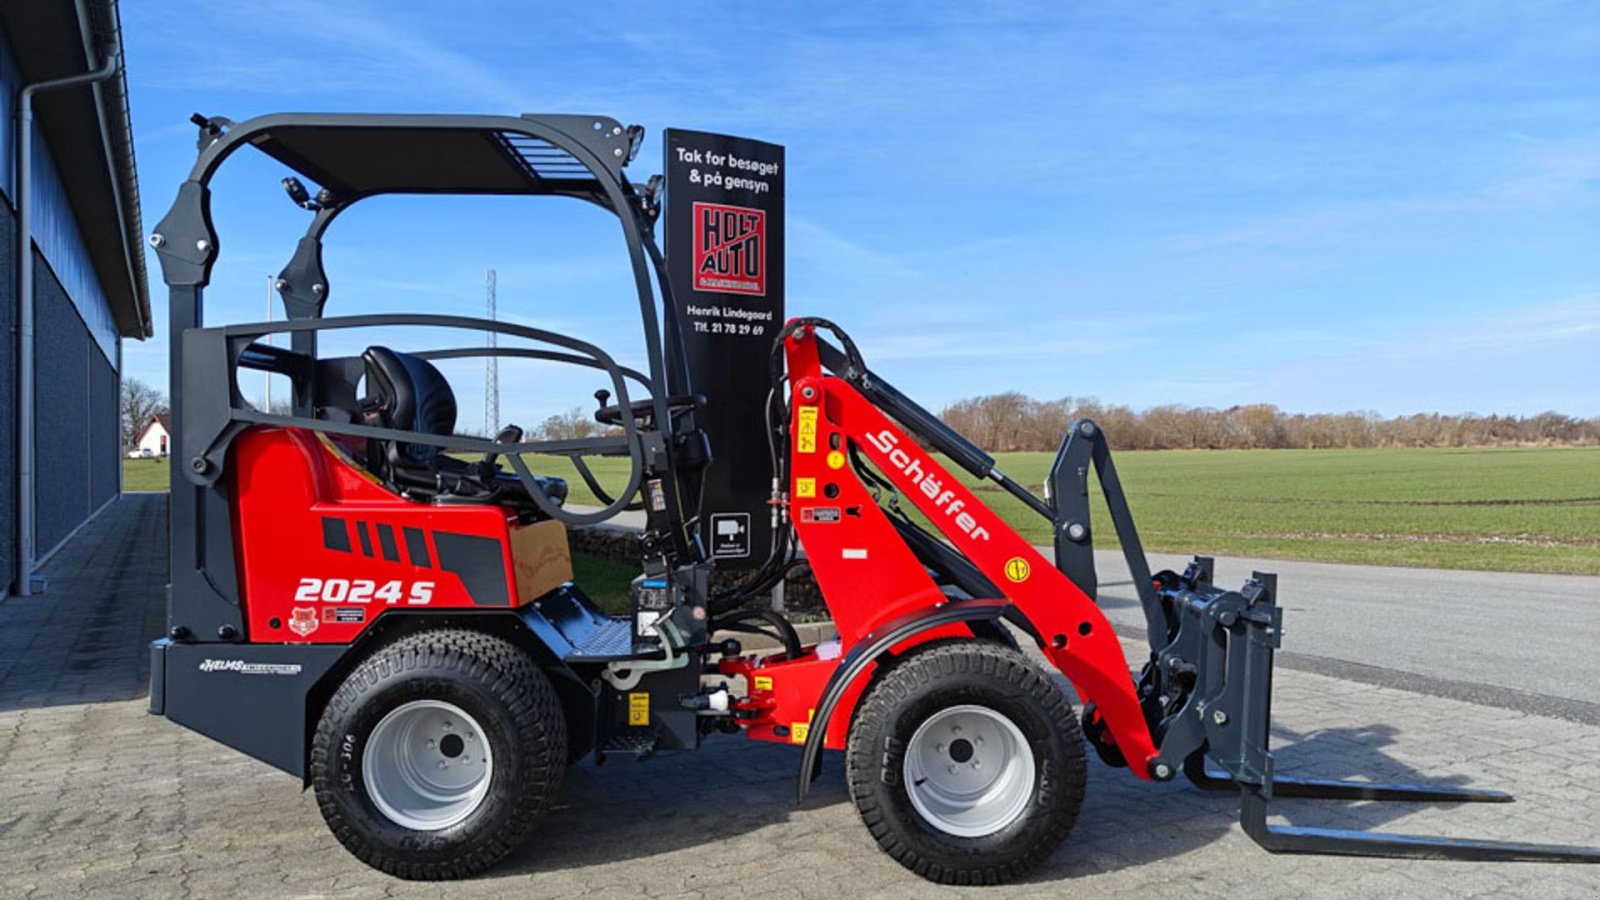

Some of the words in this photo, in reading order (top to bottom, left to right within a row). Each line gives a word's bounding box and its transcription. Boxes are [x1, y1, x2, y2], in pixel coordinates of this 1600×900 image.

[676, 147, 702, 163] Tak
[705, 150, 726, 166] for
[728, 154, 779, 176] besøget
[689, 168, 701, 183] &
[704, 171, 722, 187] på
[724, 176, 769, 194] gensyn
[703, 208, 760, 252] HOLT
[700, 234, 760, 277] AUTO
[687, 305, 720, 317] Henrik
[722, 307, 772, 321] Lindegaard
[712, 322, 722, 333] 21
[724, 323, 736, 334] 78
[738, 324, 750, 335] 29
[752, 325, 764, 336] 69
[864, 430, 990, 542] Schäffer
[294, 578, 403, 604] 2024
[408, 581, 436, 604] S
